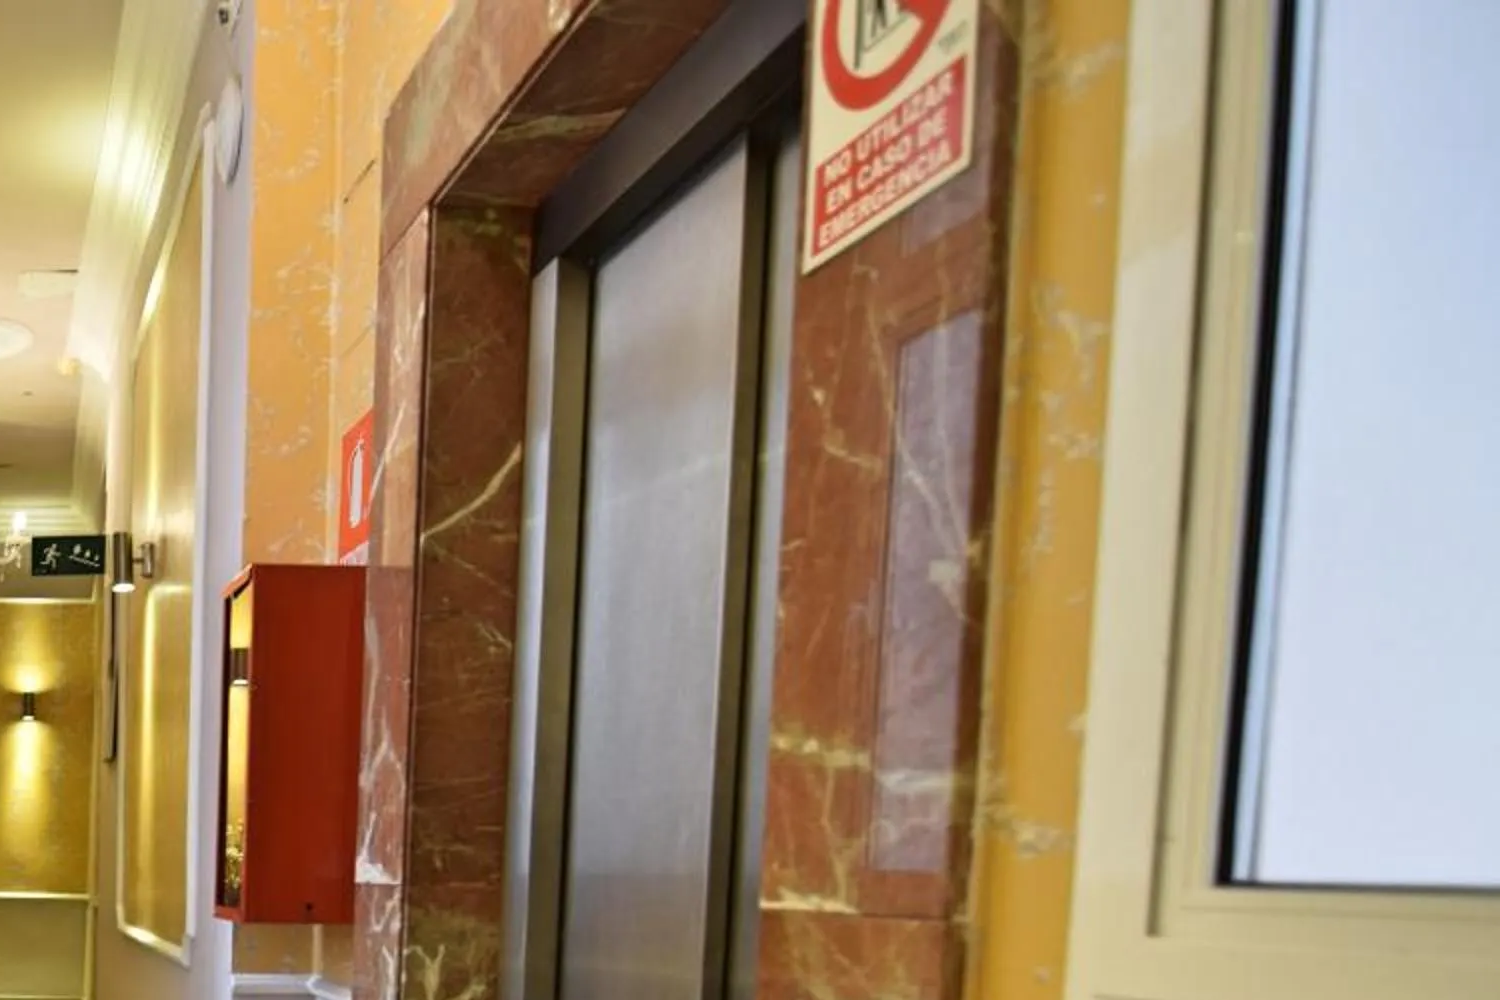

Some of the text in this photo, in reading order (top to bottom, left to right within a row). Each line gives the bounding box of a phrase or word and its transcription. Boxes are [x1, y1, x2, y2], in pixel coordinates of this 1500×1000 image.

[822, 69, 955, 188] NO UTILIZAR
[824, 106, 948, 216] EN CASO DE
[819, 138, 952, 249] EMERGENCIA
